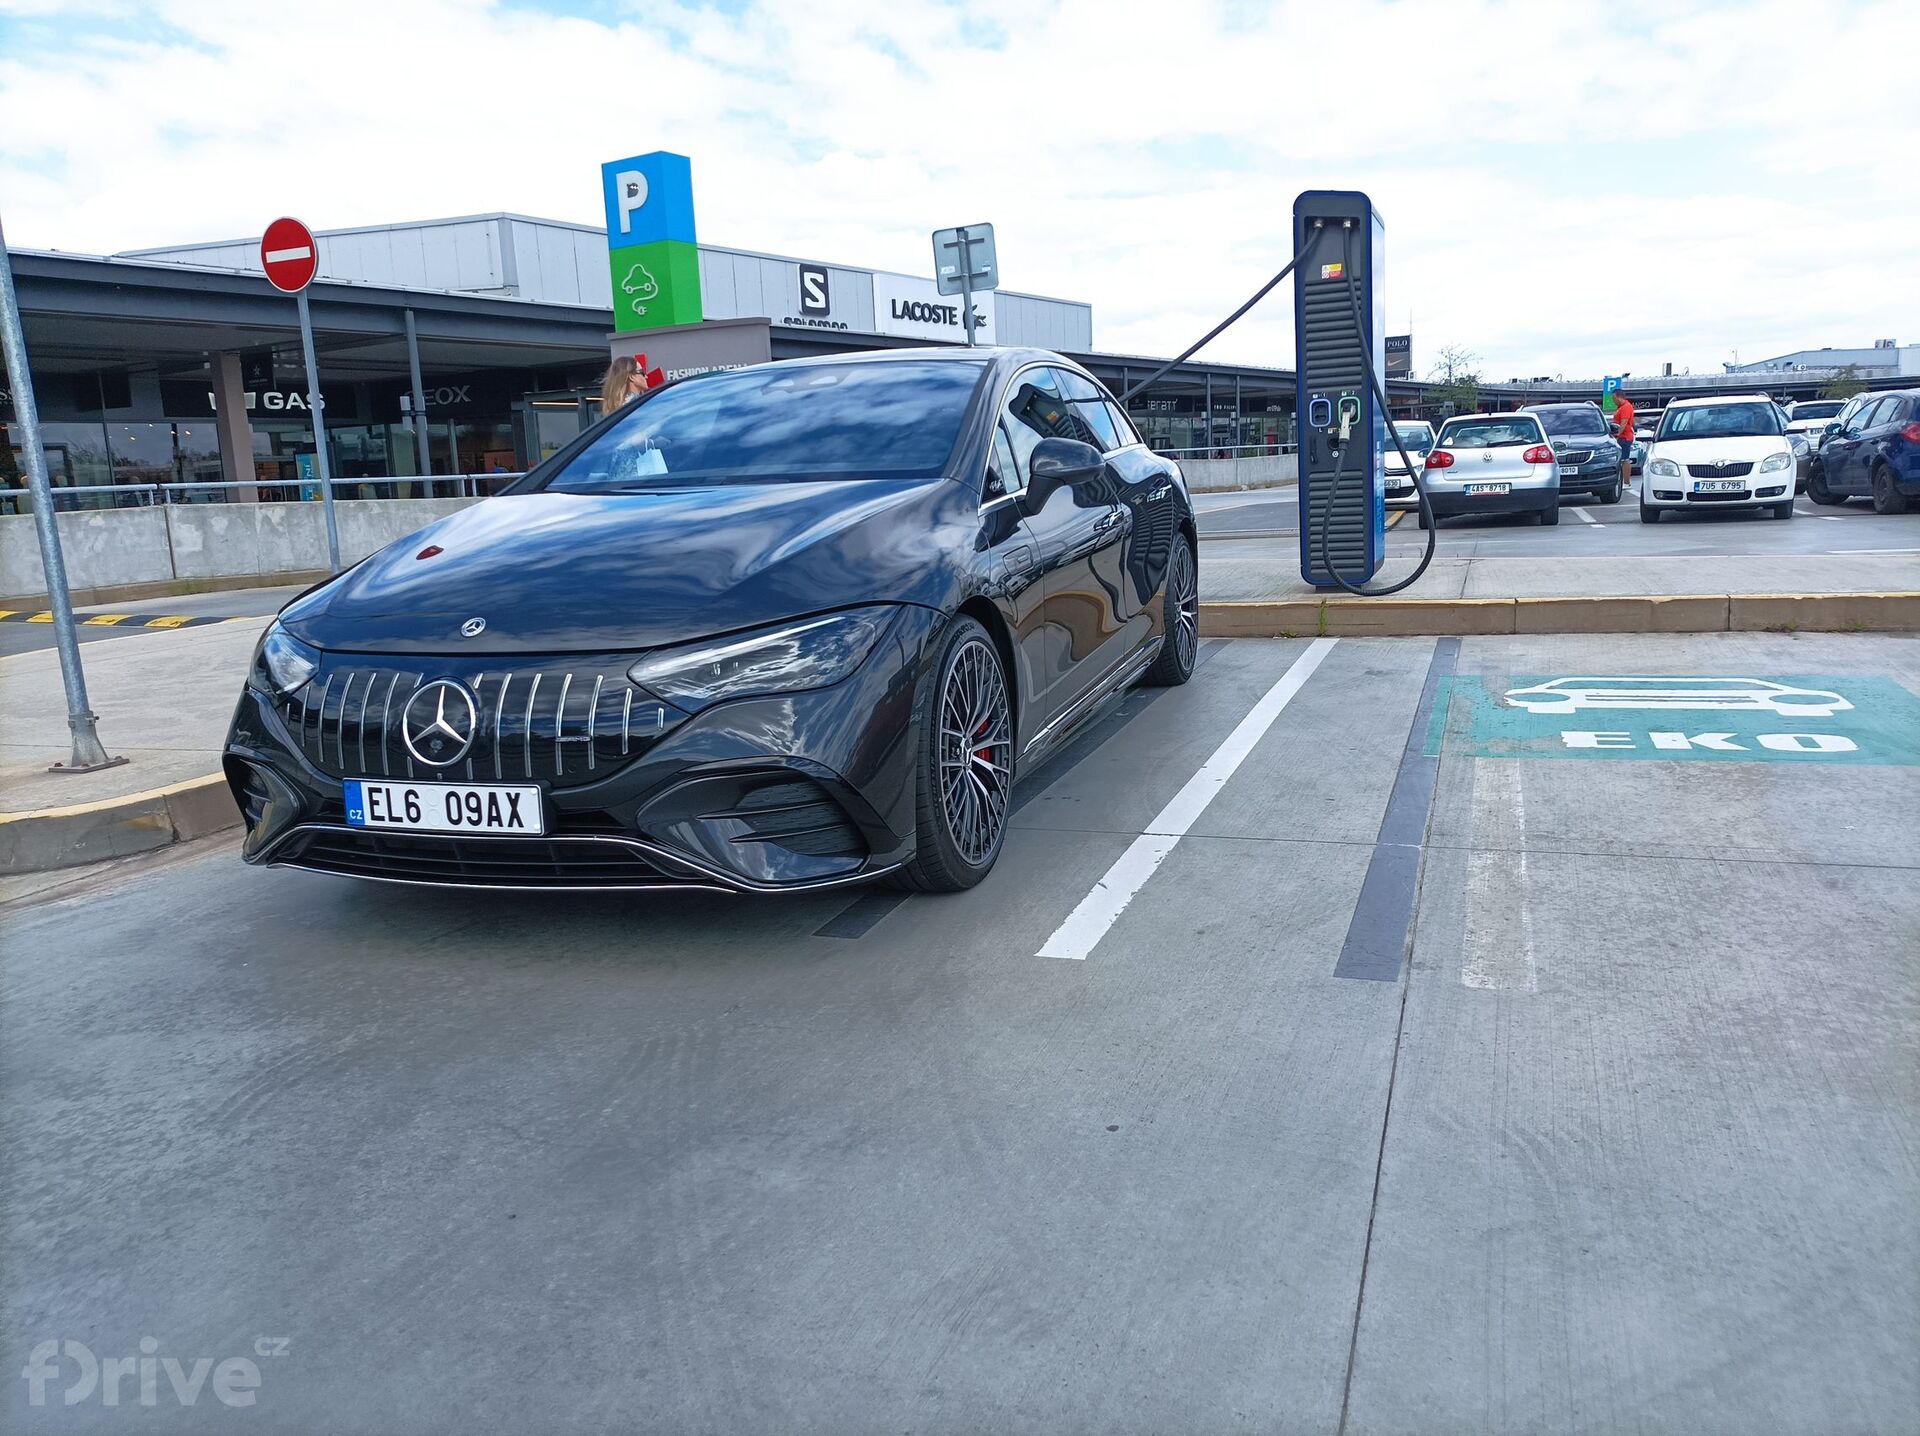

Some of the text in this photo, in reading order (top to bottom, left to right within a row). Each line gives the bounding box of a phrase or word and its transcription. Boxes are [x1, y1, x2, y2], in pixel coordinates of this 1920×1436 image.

[616, 170, 649, 234] P
[891, 298, 958, 325] LACOSTE
[667, 366, 709, 381] FASHION
[404, 385, 472, 405] EOX
[1607, 380, 1617, 391] P
[263, 391, 326, 410] GAS
[1701, 482, 1741, 490] 7U5 6795
[1560, 731, 1859, 752] EKO
[349, 809, 363, 820] CZ
[367, 786, 524, 828] EL6 09AX
